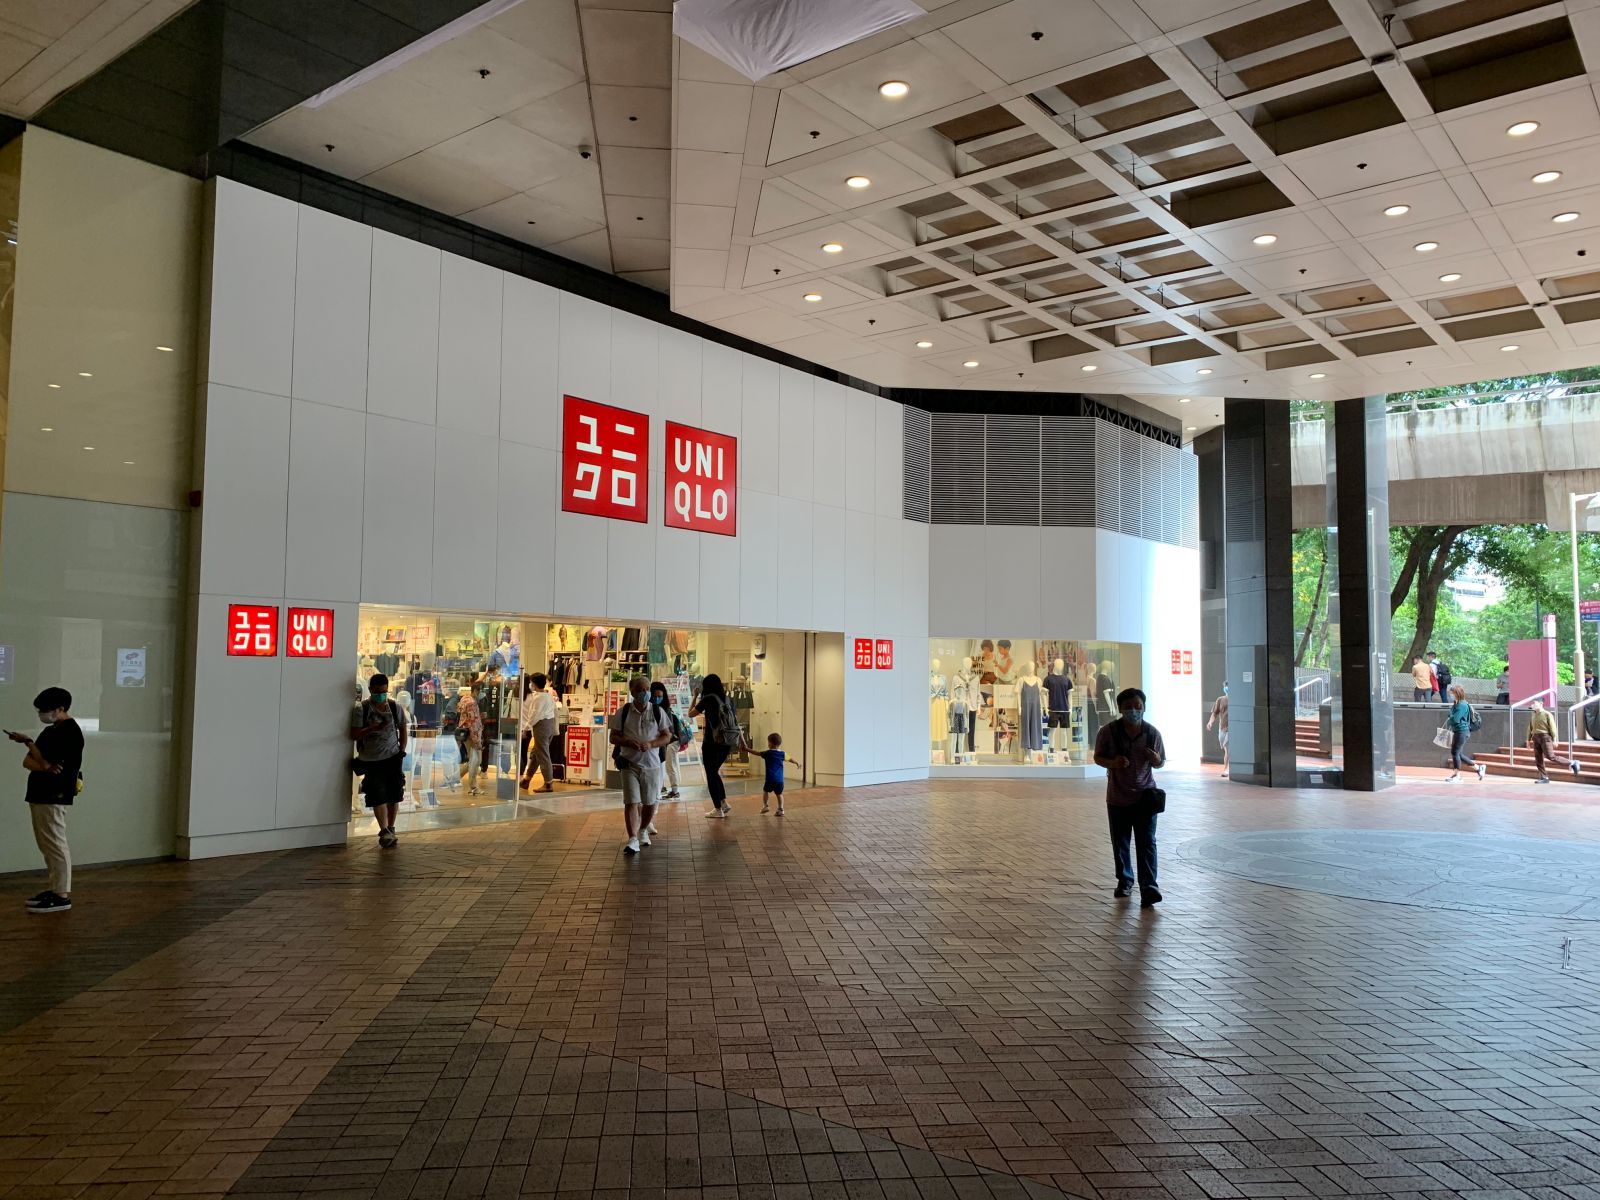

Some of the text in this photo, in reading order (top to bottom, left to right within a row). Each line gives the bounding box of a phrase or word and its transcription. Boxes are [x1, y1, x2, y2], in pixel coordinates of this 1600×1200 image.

[576, 414, 636, 462] ユニ
[674, 437, 724, 480] UNI
[572, 462, 636, 507] クロ
[674, 481, 728, 522] QLO
[293, 614, 325, 631] UNI
[292, 634, 327, 653] QLO
[877, 643, 890, 654] UNI
[877, 655, 891, 667] QLO
